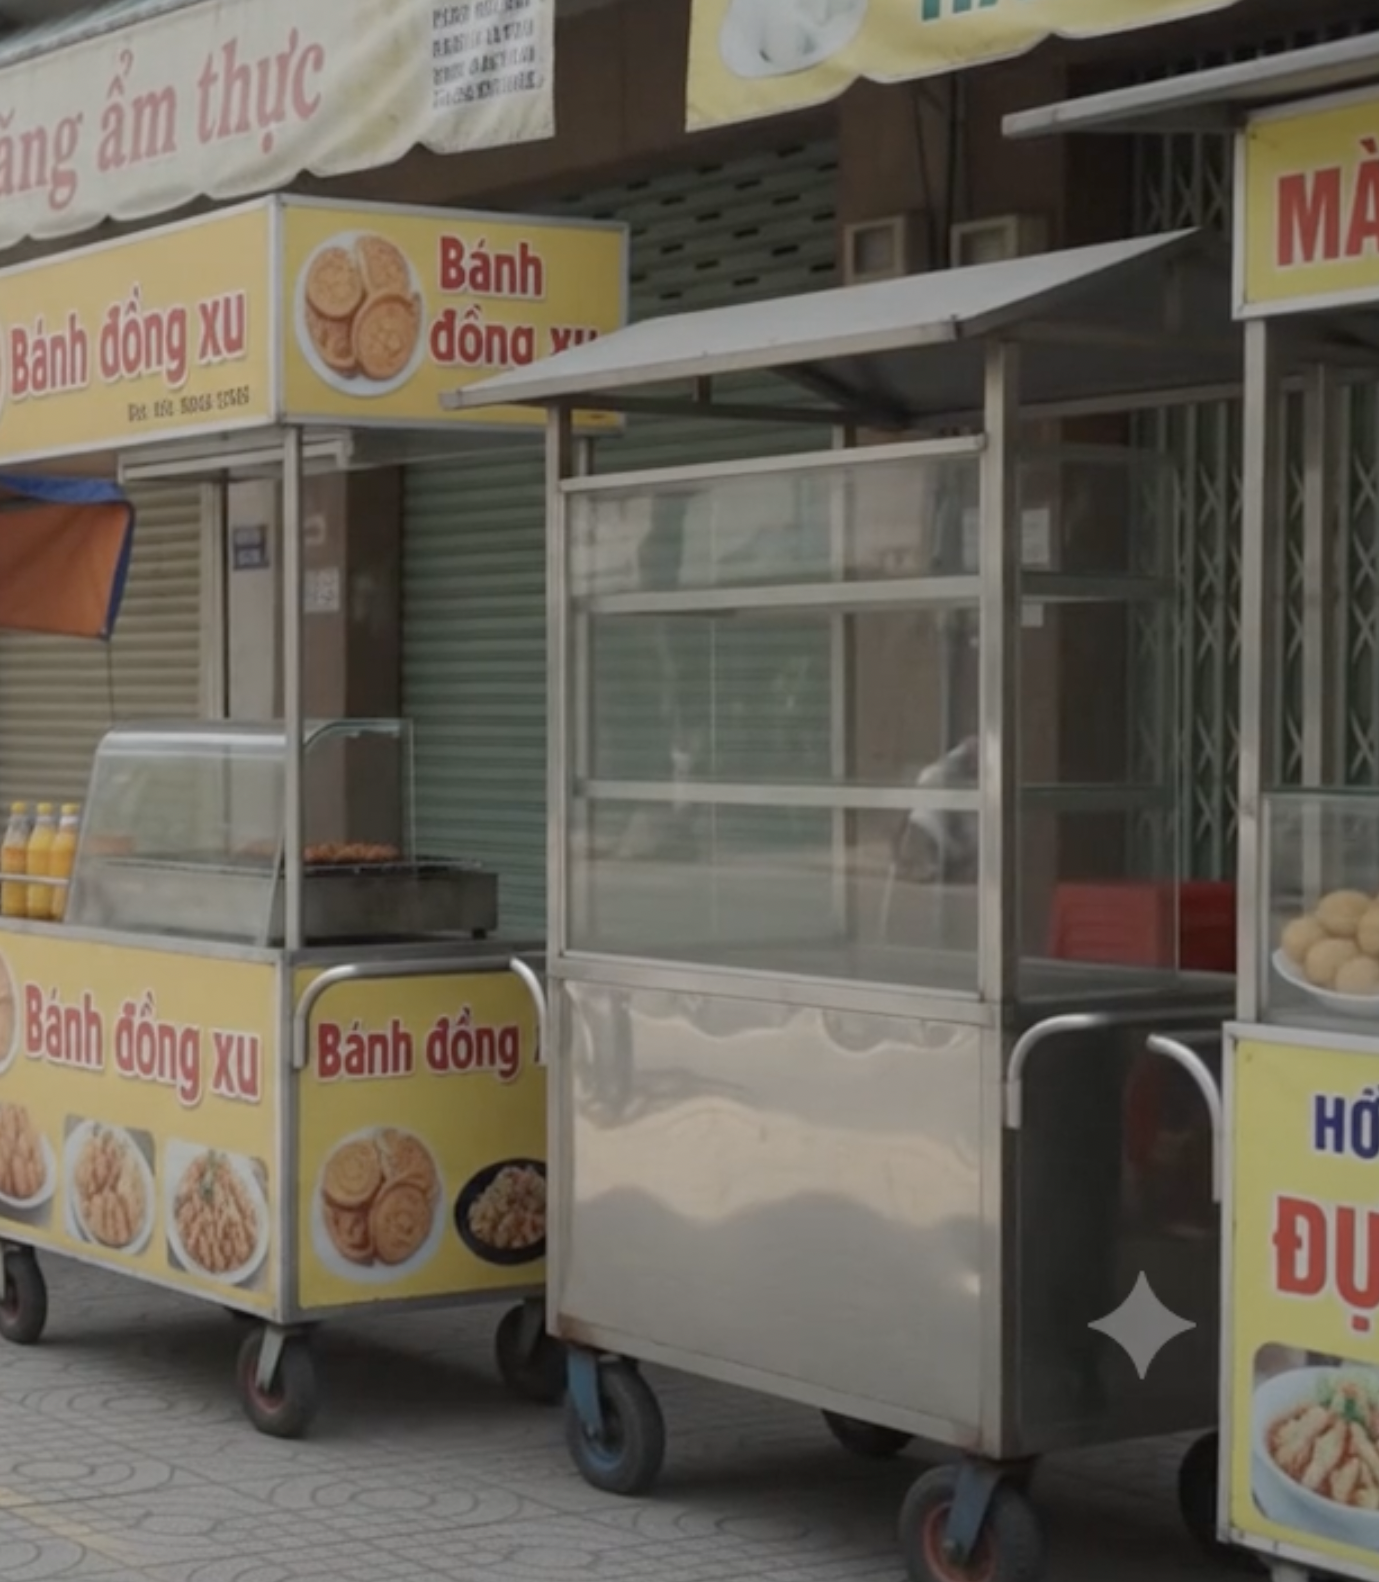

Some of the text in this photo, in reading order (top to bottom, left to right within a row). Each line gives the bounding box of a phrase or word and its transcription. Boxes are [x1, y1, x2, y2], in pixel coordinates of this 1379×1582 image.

[95, 48, 178, 173] ẩm
[196, 27, 325, 155] thực
[439, 236, 543, 296] Bánh
[10, 312, 88, 396] Bánh
[197, 293, 245, 360] xu
[429, 303, 535, 366] đồng
[24, 984, 260, 1103] Bánh đồng xu
[317, 1014, 413, 1078] Bánh
